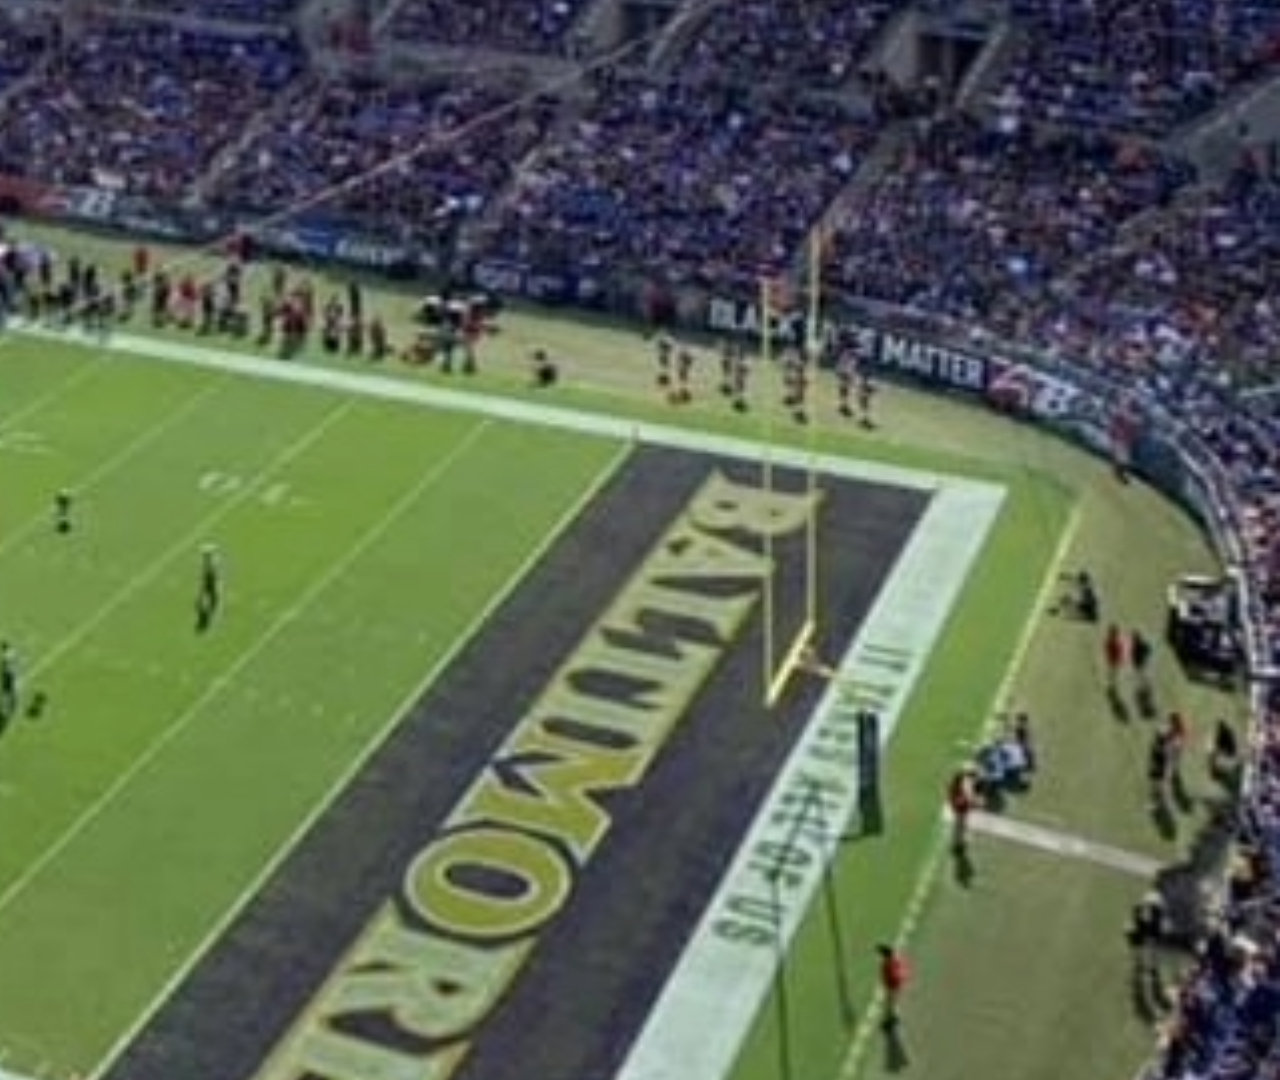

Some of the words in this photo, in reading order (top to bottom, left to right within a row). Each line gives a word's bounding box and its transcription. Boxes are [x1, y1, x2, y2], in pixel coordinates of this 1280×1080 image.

[710, 298, 805, 342] BLAK
[881, 332, 985, 390] MATTER
[252, 467, 825, 1080] BALTIMOR
